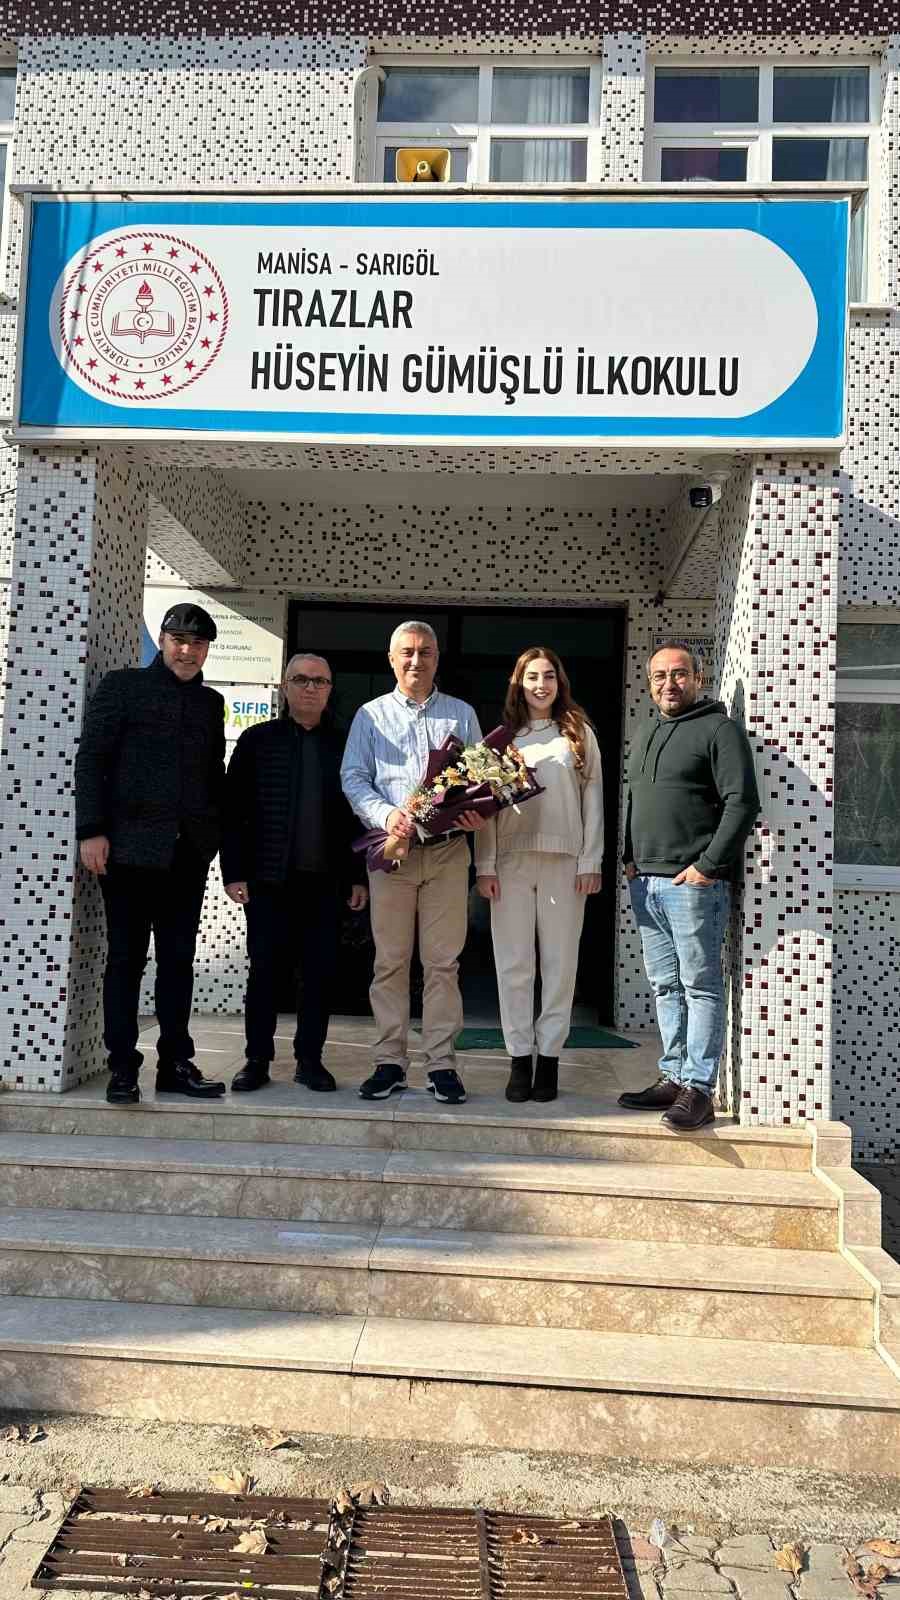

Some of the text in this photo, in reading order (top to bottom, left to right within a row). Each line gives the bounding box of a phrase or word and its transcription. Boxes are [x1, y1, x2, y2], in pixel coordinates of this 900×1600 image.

[257, 247, 332, 275] MANİSA
[356, 248, 440, 276] SARIGÖL
[90, 262, 197, 367] TÜRKİYE CUMHURİYETİ MİLLİ EĞİTİM BAKANLIĞI
[254, 288, 413, 329] TIRAZLAR
[251, 342, 739, 405] HÜSEYİN GÜMÜŞLÜ İLKOKULU
[232, 701, 269, 715] SIFIR
